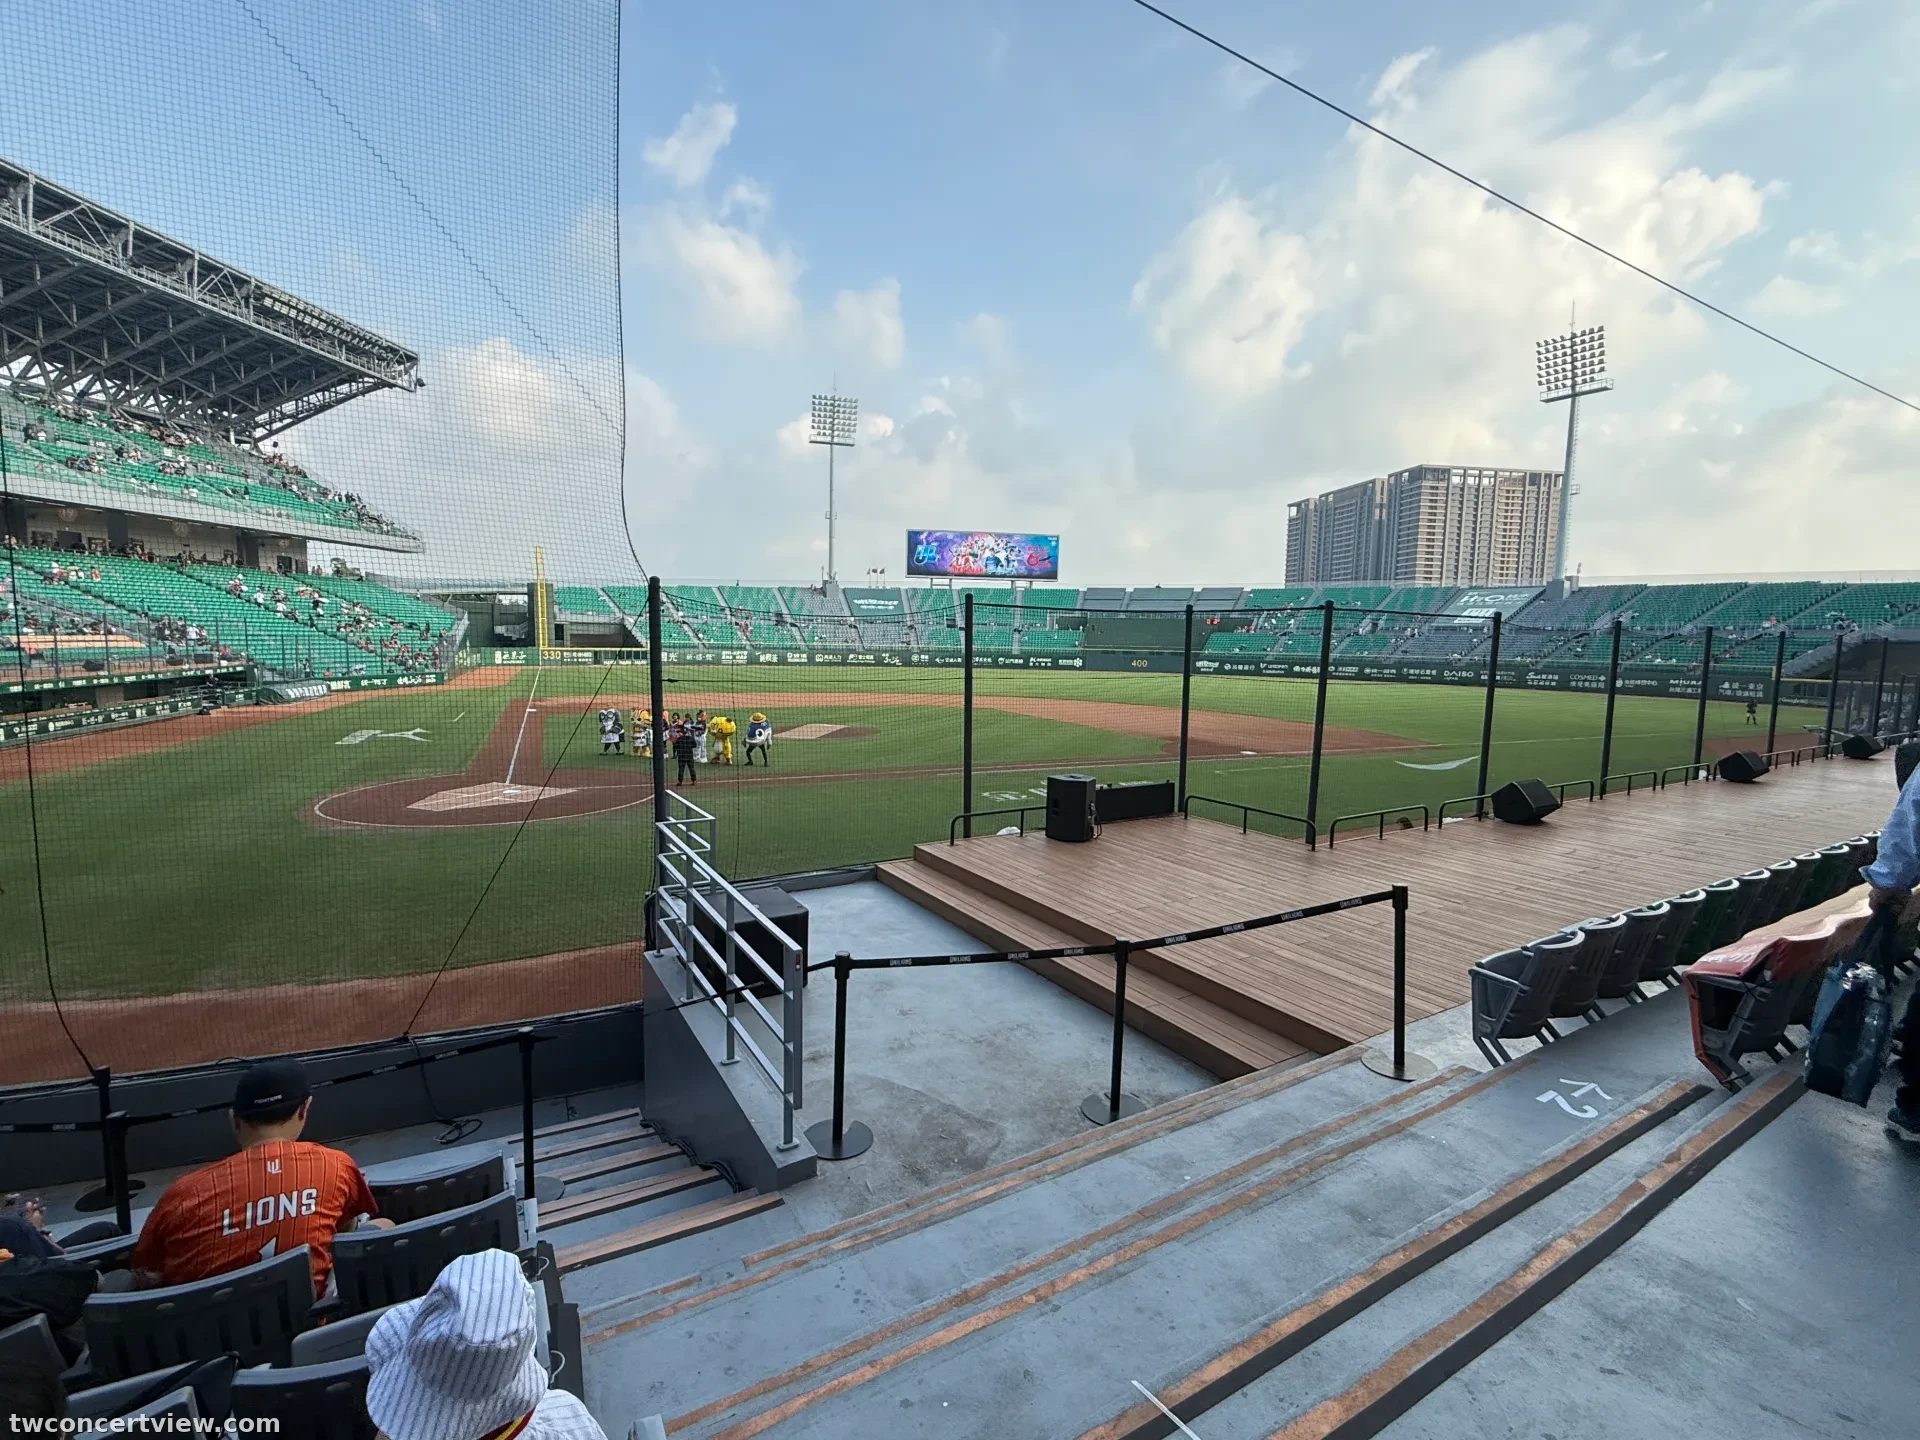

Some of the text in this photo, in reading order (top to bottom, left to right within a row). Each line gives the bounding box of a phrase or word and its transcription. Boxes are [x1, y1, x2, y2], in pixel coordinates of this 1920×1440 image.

[542, 650, 561, 660] 330
[1131, 660, 1148, 668] 400
[1443, 670, 1474, 678] DAISO
[1569, 673, 1598, 681] COSMED
[222, 1188, 318, 1237] LIONS
